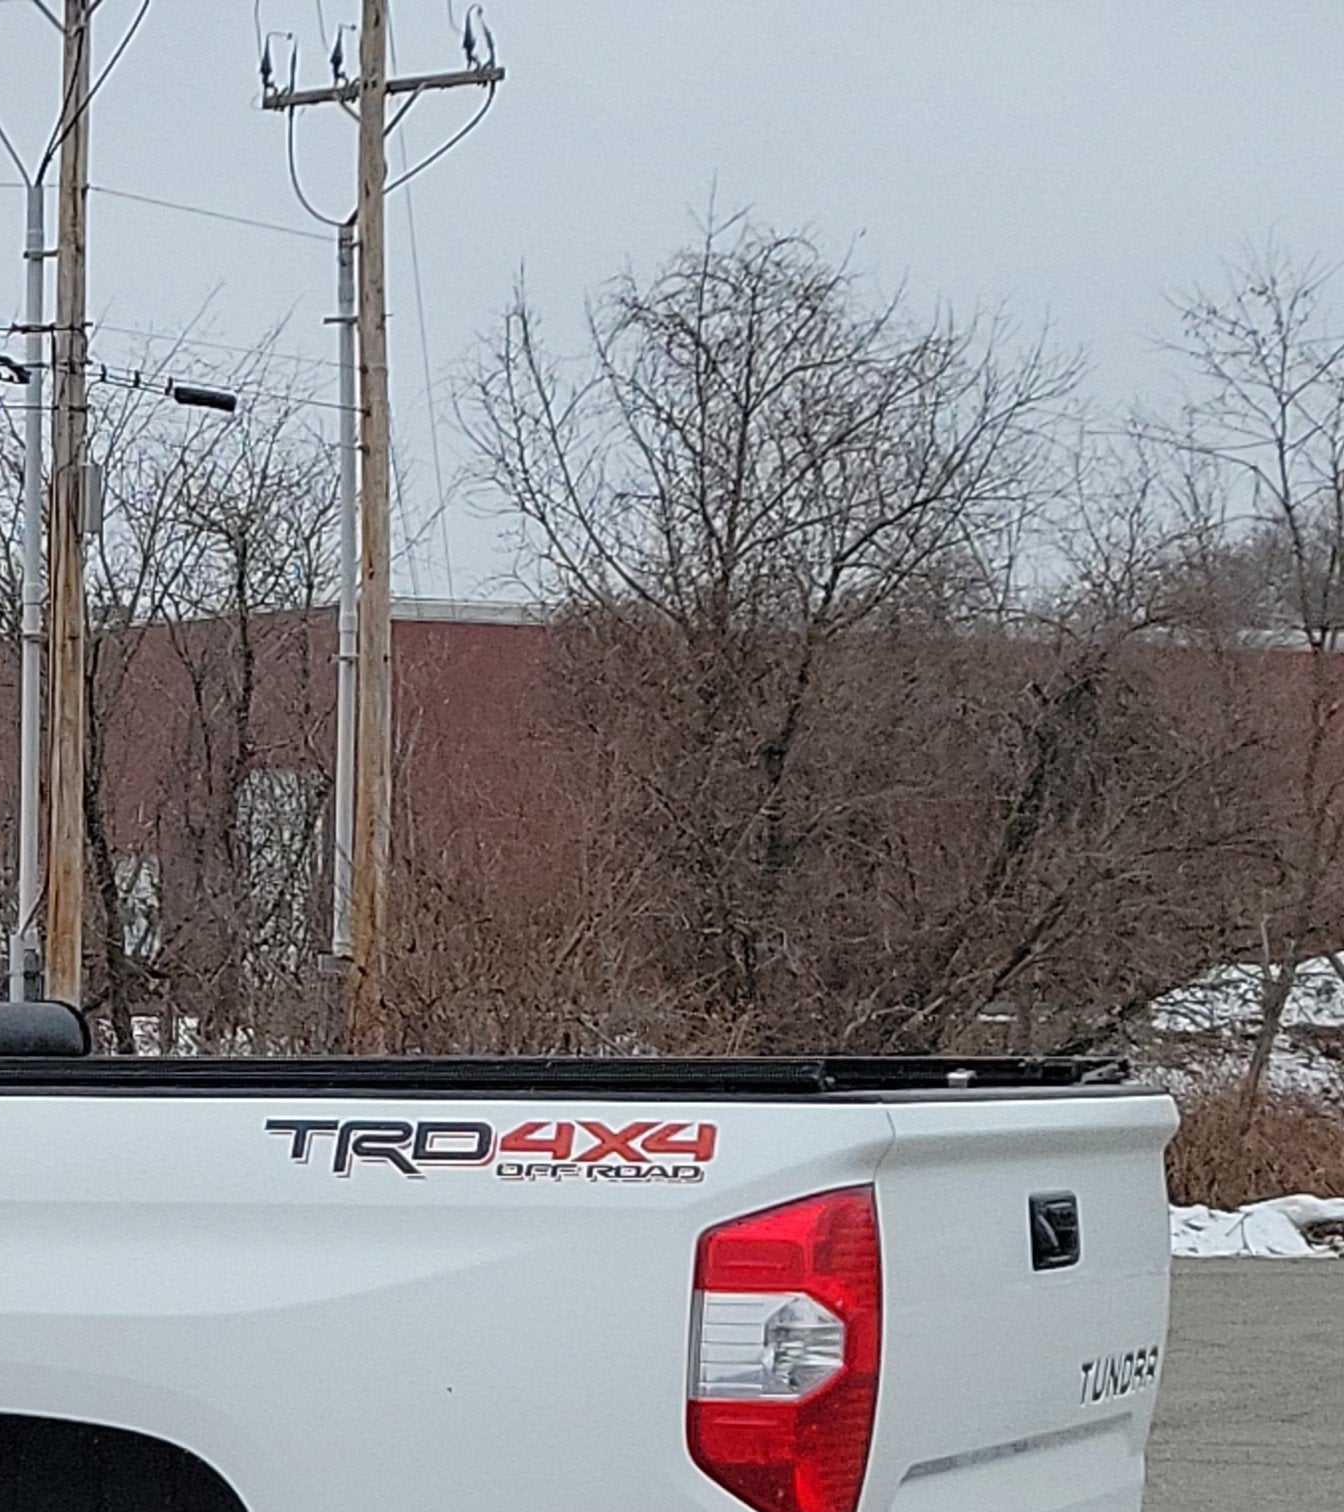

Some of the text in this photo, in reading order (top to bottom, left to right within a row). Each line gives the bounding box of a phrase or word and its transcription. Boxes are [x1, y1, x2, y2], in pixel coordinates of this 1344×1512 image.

[264, 1118, 496, 1178] TRD
[496, 1163, 704, 1182] OFF ROAD
[1079, 1346, 1159, 1405] TUNDRA
